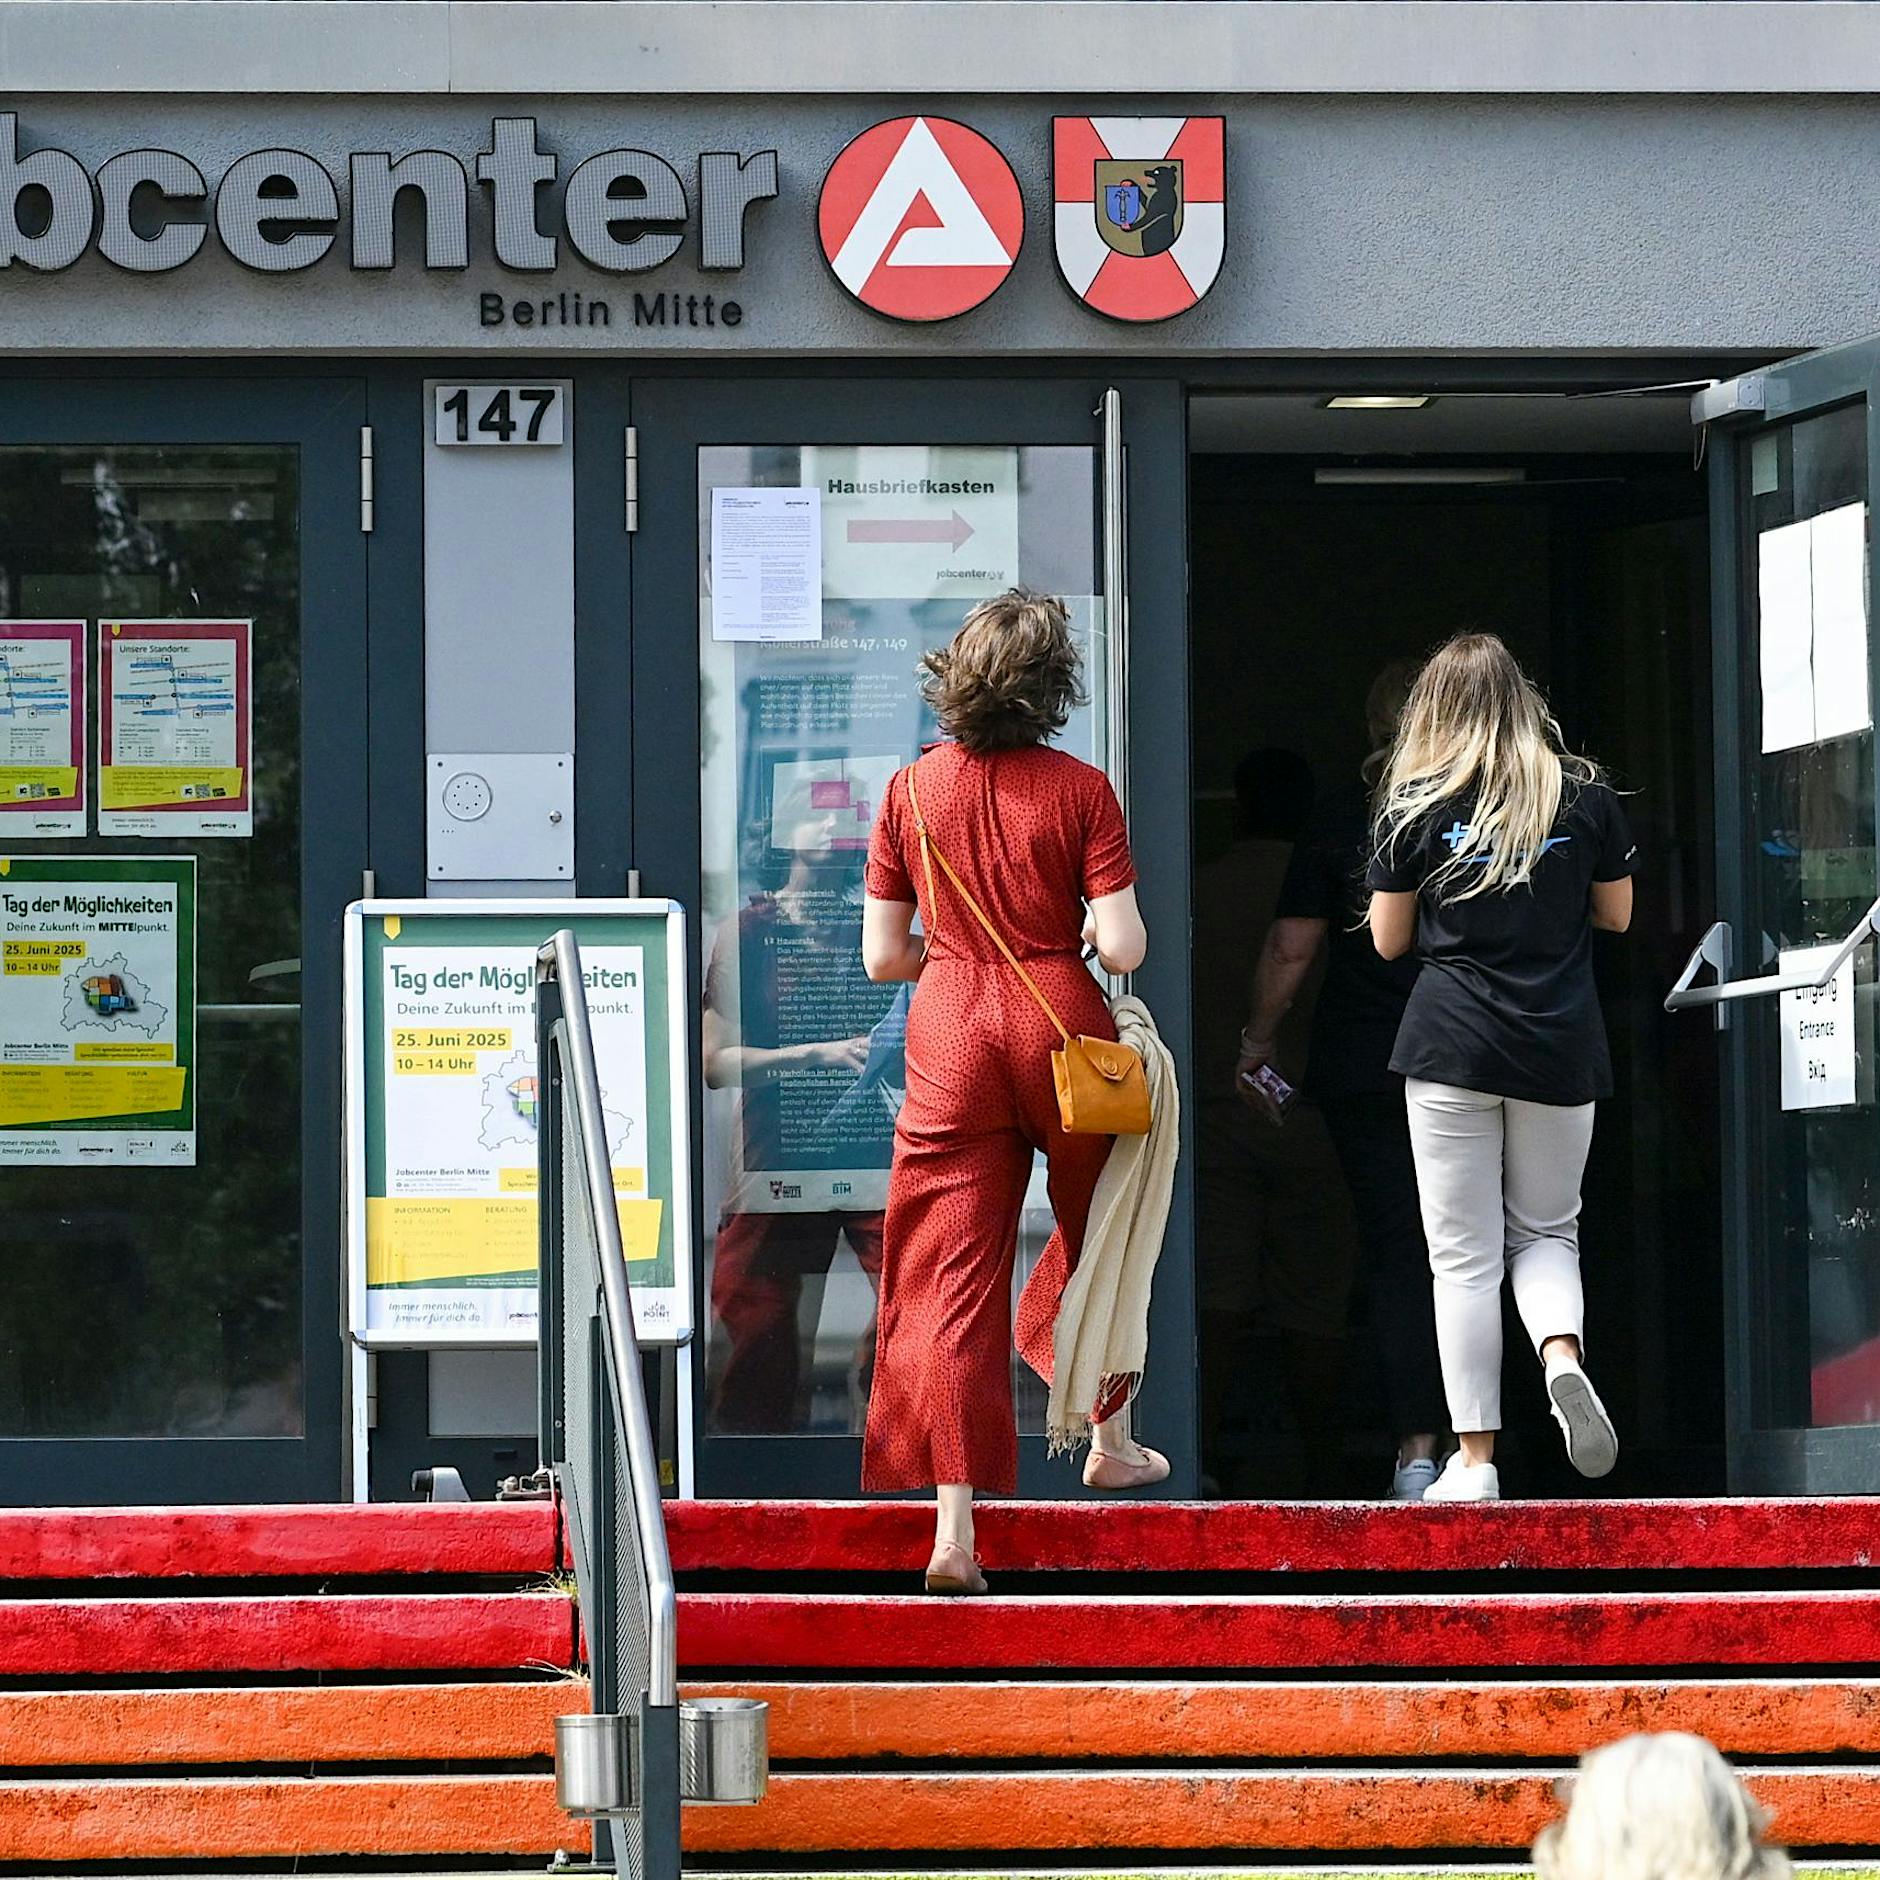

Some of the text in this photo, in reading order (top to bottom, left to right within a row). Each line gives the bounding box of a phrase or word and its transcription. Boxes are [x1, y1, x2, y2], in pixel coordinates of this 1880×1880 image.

[480, 293, 744, 327] Berlin Mitte
[443, 389, 555, 442] 147
[827, 479, 996, 494] Hausbriefkasten
[936, 568, 987, 580] jobcenter
[2, 893, 174, 918] Tag der Möglichkeiten
[6, 921, 170, 934] Deine Zukunft im MITTElpunkt.
[6, 945, 82, 956] 25. Juni 2025
[6, 963, 18, 973] 10
[27, 963, 39, 973] 14
[40, 963, 60, 973] Uhr
[390, 963, 637, 995] Tag der Mögleiten
[397, 1001, 440, 1016] Deine
[444, 1001, 503, 1016] Zukunft
[507, 1001, 526, 1016] im
[1799, 1020, 1835, 1040] Entrance
[396, 1033, 507, 1046] 25. Juni 2025
[397, 1057, 413, 1070] 10
[428, 1057, 444, 1070] 14
[448, 1057, 474, 1070] Uhr
[396, 1168, 490, 1176] Jobcenter Berlin Mitte
[388, 1302, 477, 1312] Immer menschlich.
[395, 1313, 428, 1324] Immer
[428, 1313, 446, 1324] für
[446, 1313, 466, 1324] dich
